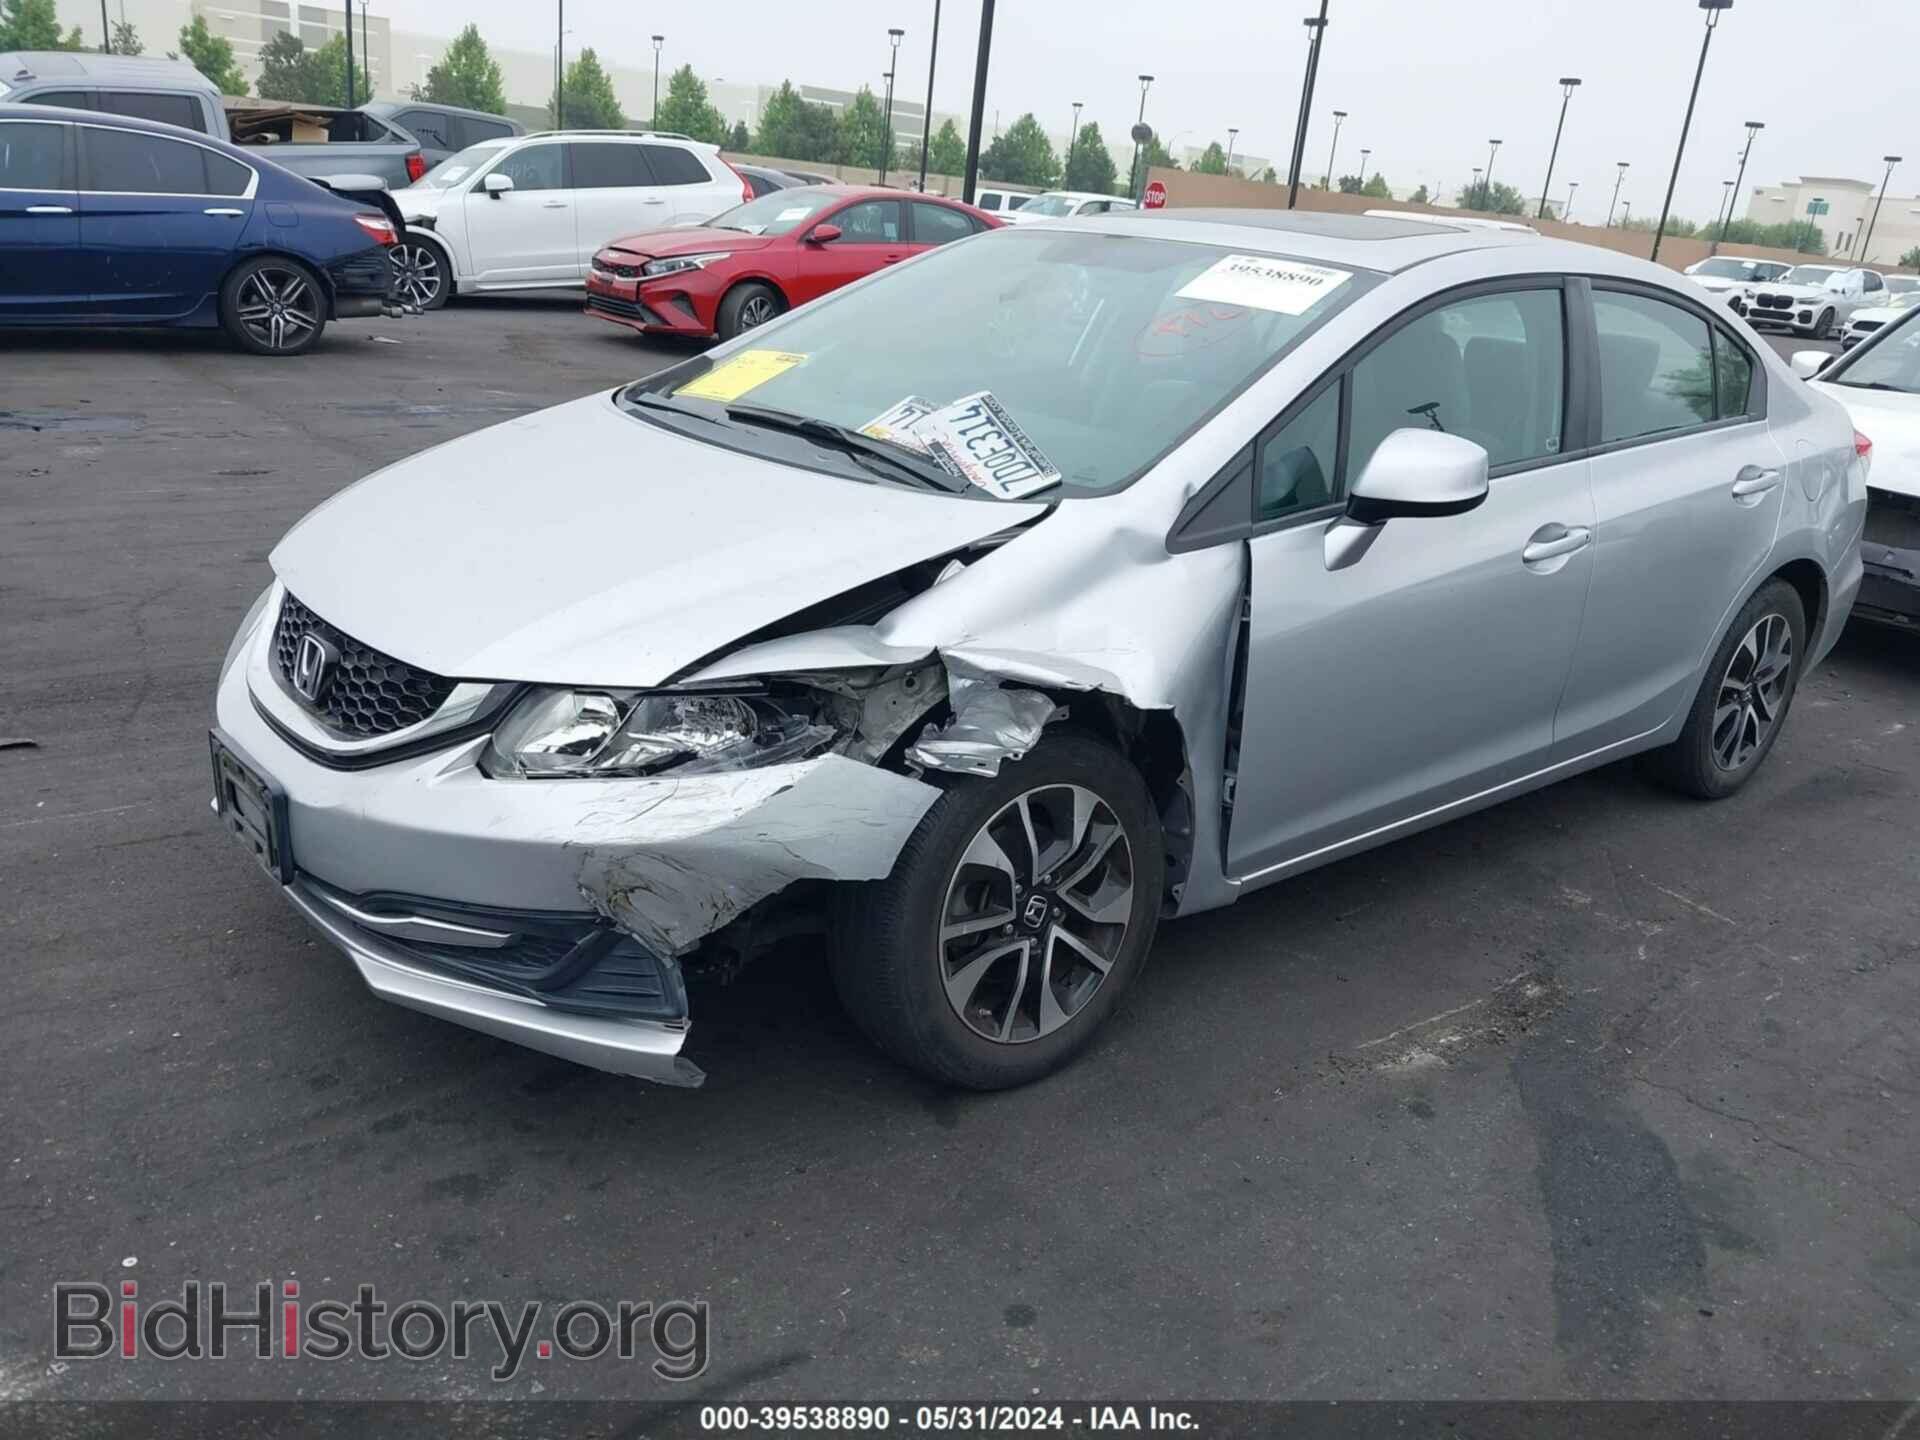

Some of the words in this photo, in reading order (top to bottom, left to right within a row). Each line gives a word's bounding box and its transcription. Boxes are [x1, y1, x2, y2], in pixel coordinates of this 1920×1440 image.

[1145, 190, 1166, 205] STOP
[1227, 262, 1325, 288] 39538890
[949, 403, 1041, 492] 7DQE314
